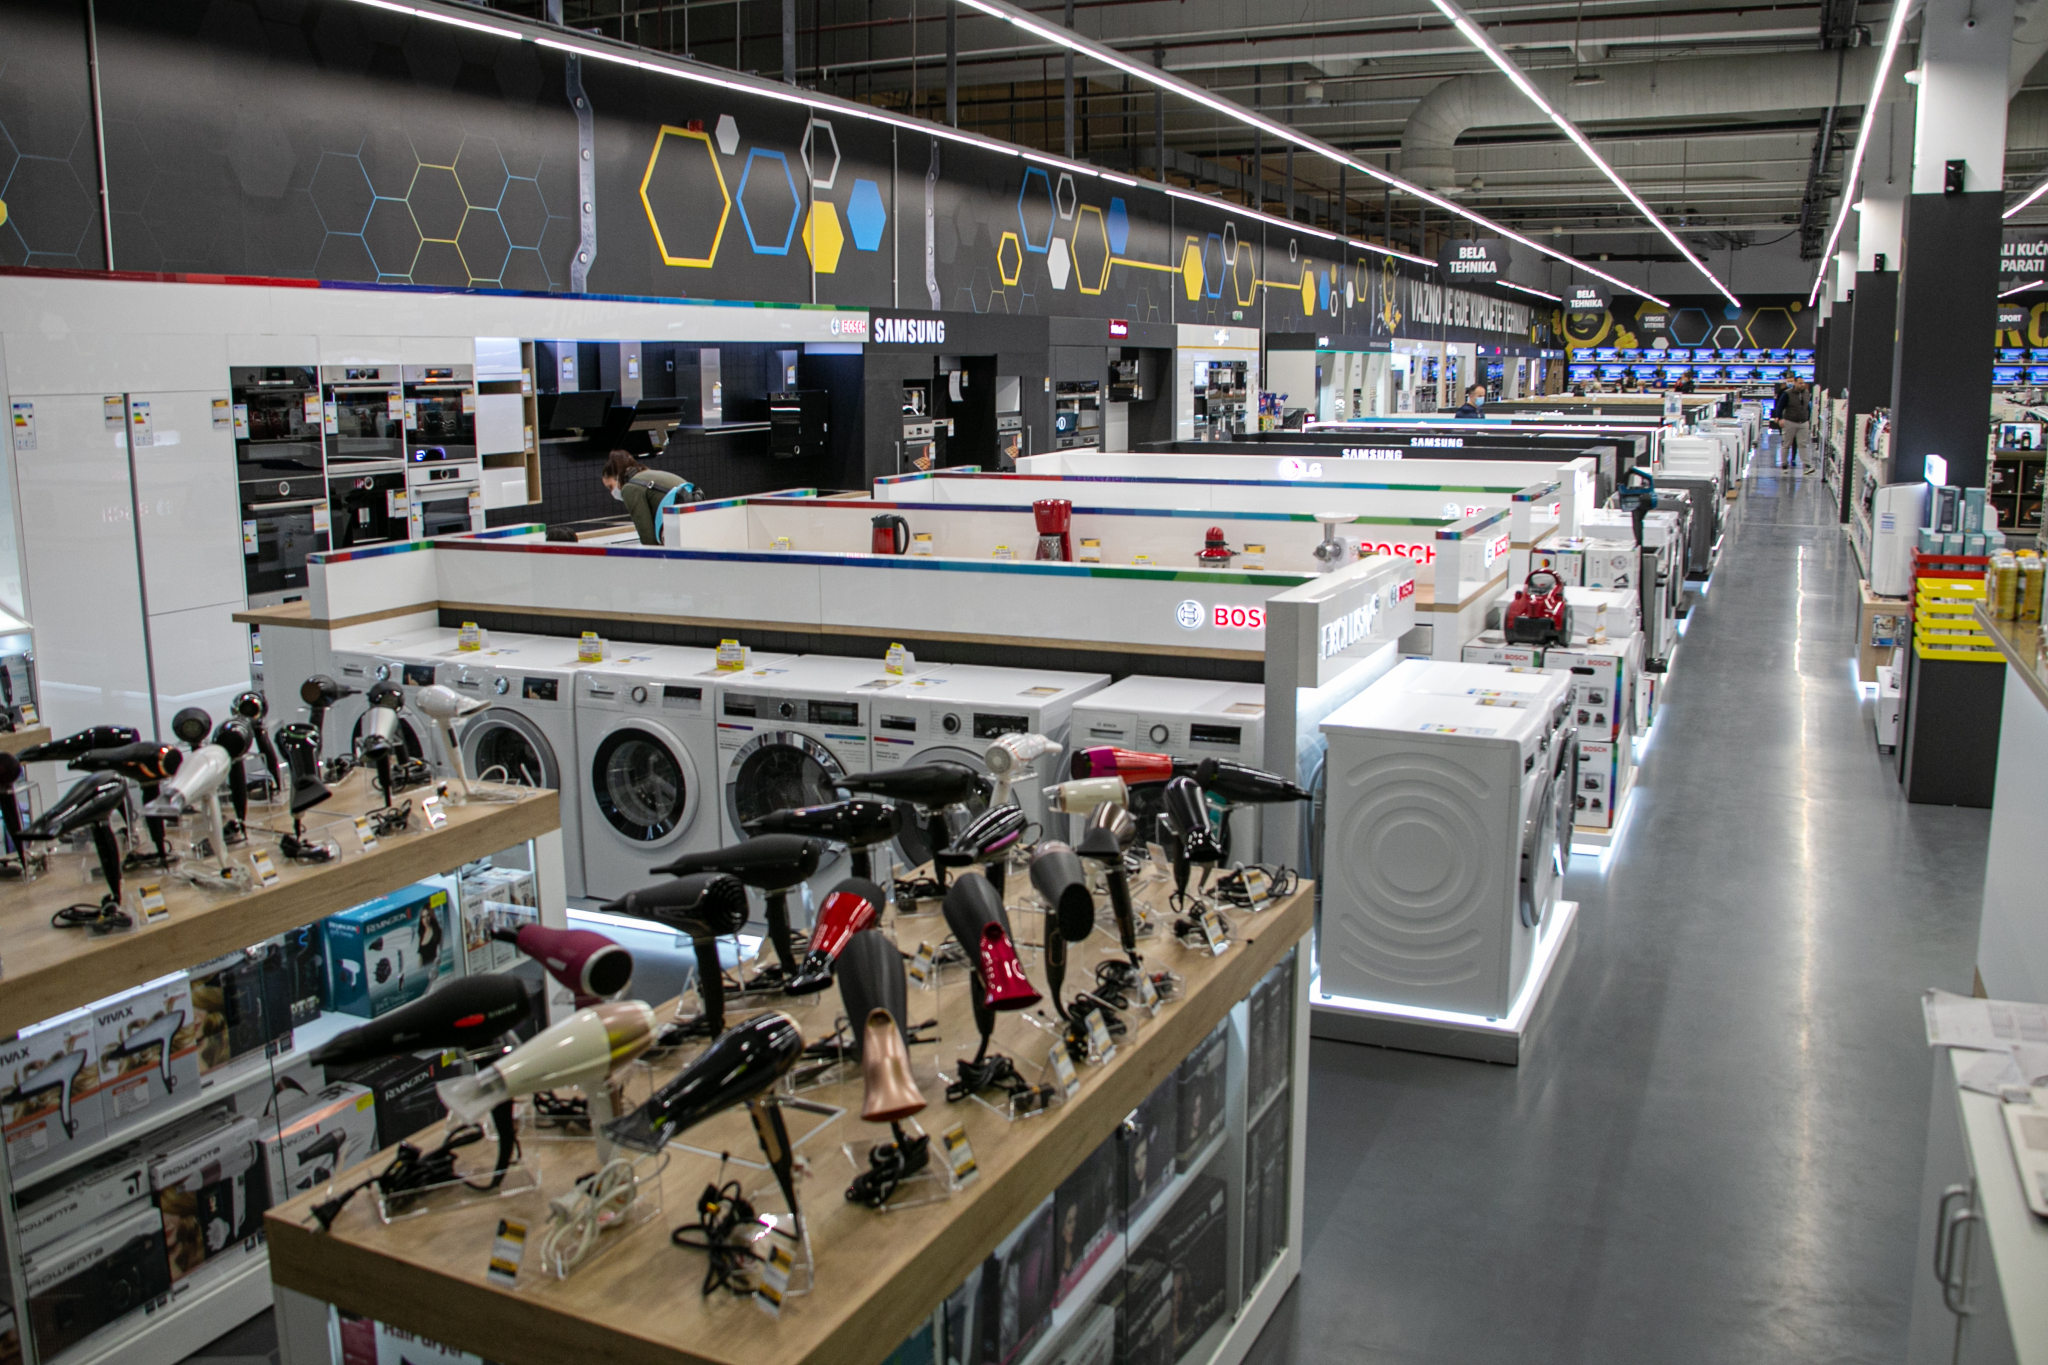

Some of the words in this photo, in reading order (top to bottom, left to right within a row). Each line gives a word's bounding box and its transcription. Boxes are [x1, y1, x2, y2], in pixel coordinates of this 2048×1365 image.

[1459, 247, 1487, 259] BELA
[1449, 261, 1498, 273] TEHNIKA
[2000, 259, 2046, 272] PARATI
[1576, 289, 1596, 299] BELA
[1411, 273, 1442, 325] VAŽNO
[1443, 288, 1454, 326] JE
[1454, 289, 1470, 328] GDE
[1570, 299, 1603, 309] TEHNIKA
[1999, 314, 2022, 323] SPORT
[875, 317, 945, 344] SAMSUNG
[1410, 437, 1464, 448] SAMSUNG
[1342, 449, 1403, 460] SAMSUNG
[1302, 462, 1323, 478] LG
[1214, 607, 1267, 628] BOS
[1504, 654, 1528, 662] BOSCH
[1587, 659, 1612, 667] BOSCH
[98, 1006, 134, 1026] VIVAX
[385, 1070, 430, 1101] REMINGTON
